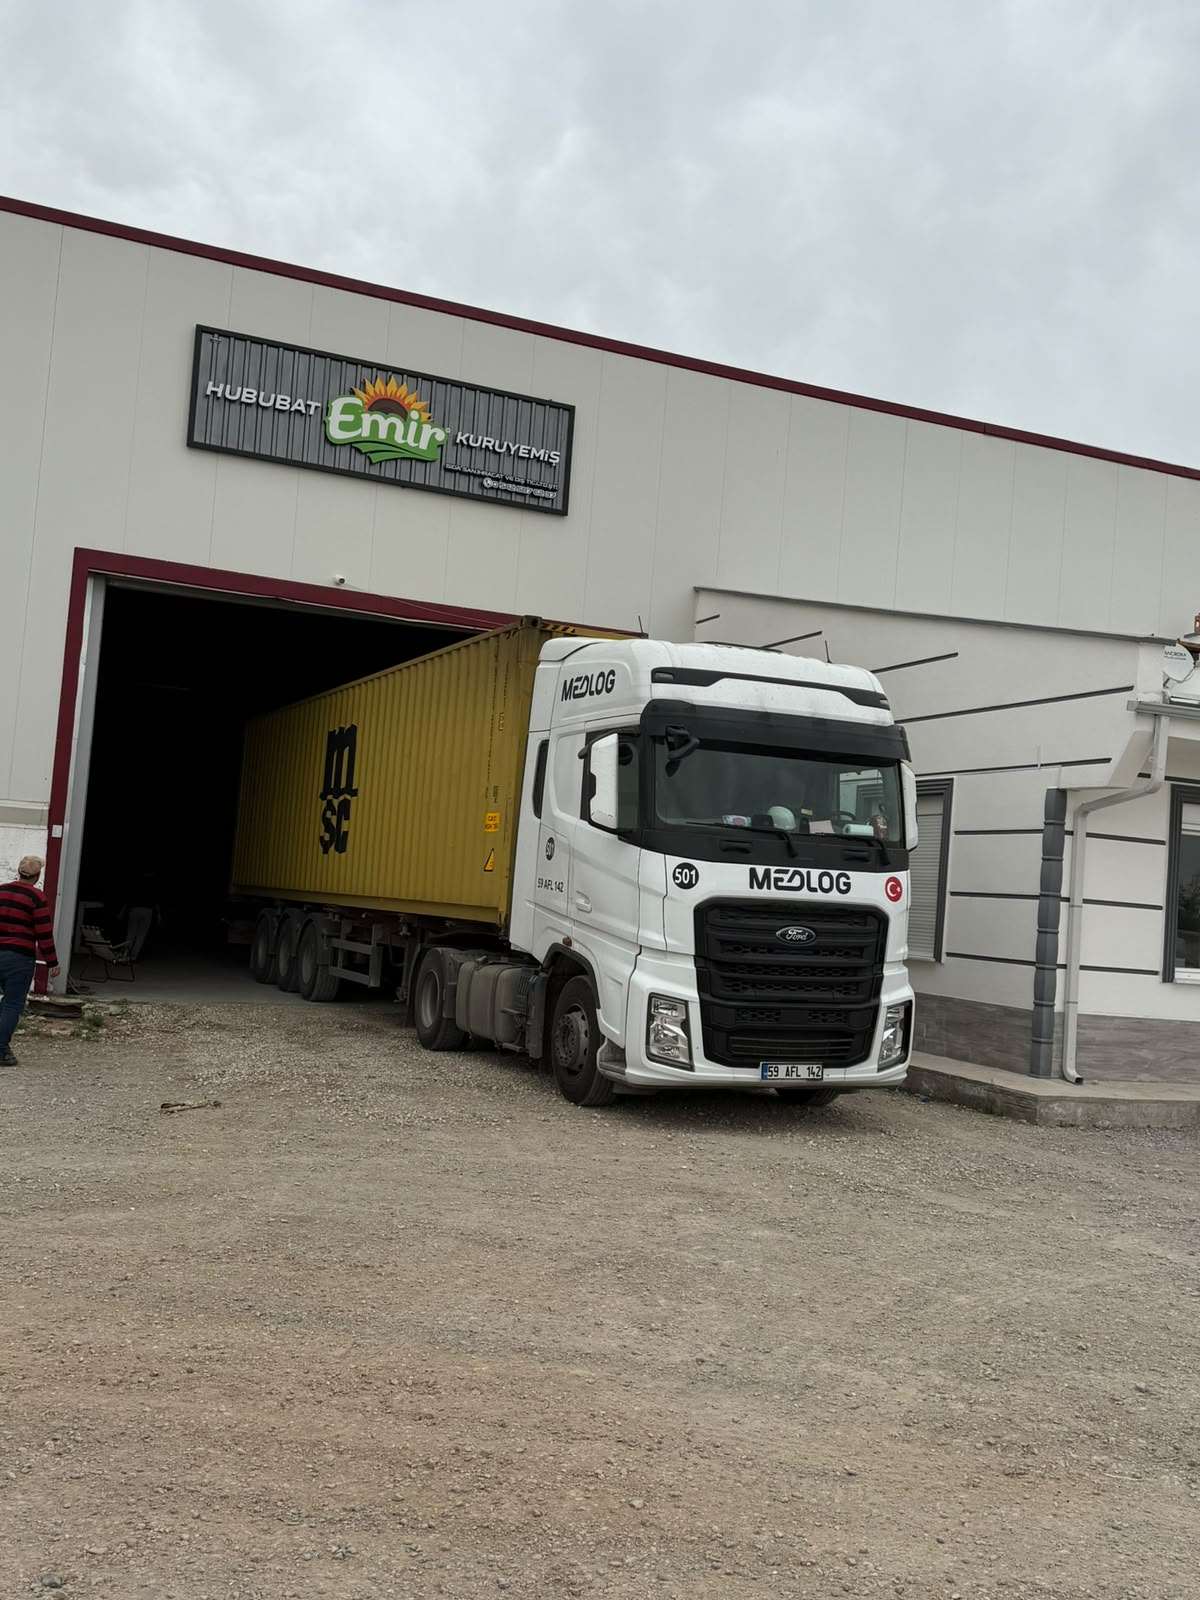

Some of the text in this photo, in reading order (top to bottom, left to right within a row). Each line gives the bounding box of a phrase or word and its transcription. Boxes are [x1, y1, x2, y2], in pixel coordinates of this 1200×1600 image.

[205, 381, 322, 417] HUBUBAT
[328, 396, 447, 451] Emir
[561, 669, 616, 702] MEDLOG
[537, 877, 564, 893] 59 AFL 142
[675, 868, 697, 885] 501
[749, 866, 852, 895] MEDLOG
[785, 928, 808, 942] Ford
[768, 1065, 821, 1078] 59 AFL 142
